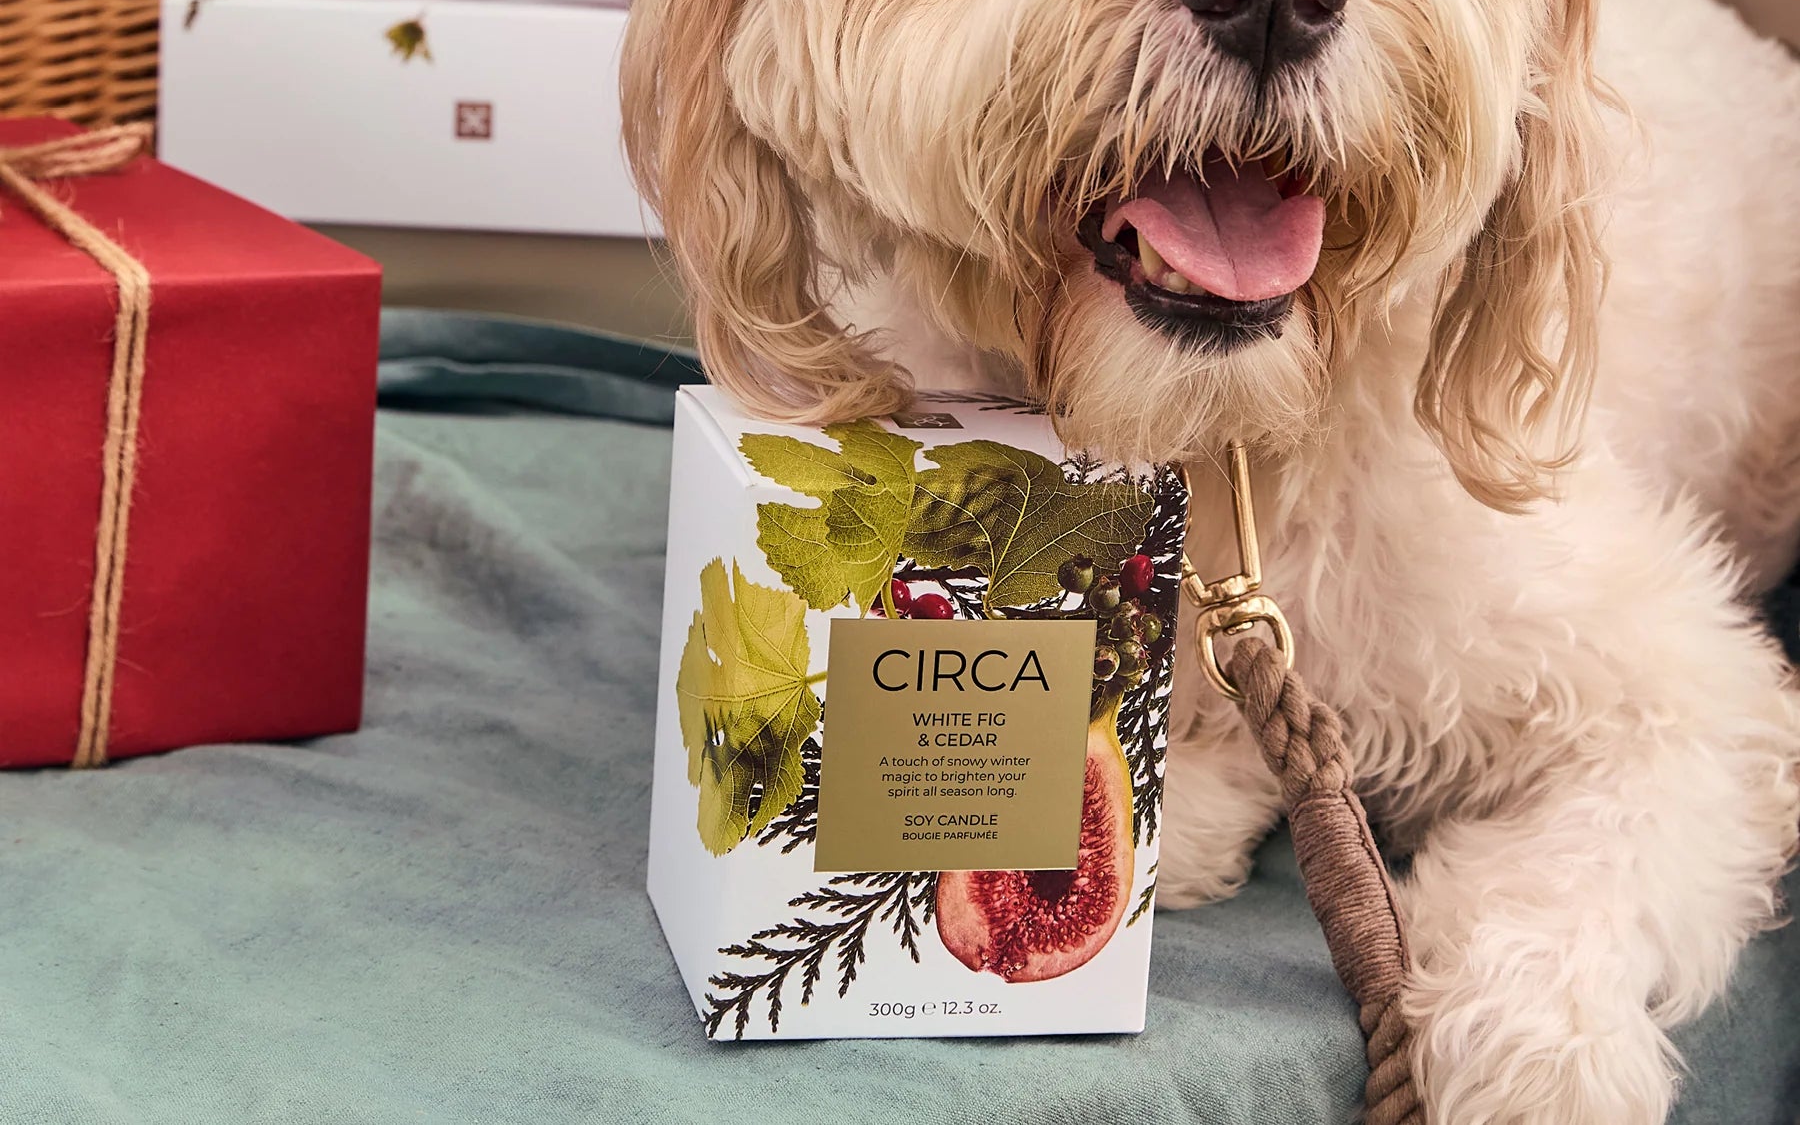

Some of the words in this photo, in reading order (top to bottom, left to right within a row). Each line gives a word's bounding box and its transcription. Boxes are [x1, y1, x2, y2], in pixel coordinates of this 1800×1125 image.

[872, 649, 1050, 692] CIRCA
[912, 712, 972, 726] WHITE
[977, 712, 1006, 726] FIG
[917, 733, 930, 747] &
[934, 733, 998, 747] CEDAR
[879, 756, 889, 767] A
[891, 756, 929, 767] touch
[932, 756, 945, 767] of
[947, 758, 988, 769] snowy
[990, 756, 1031, 767] winter
[881, 771, 923, 784] magic
[925, 772, 938, 782] to
[941, 771, 995, 784] brighten
[998, 772, 1027, 783] your
[888, 786, 919, 799] spirit
[922, 786, 937, 797] all
[940, 787, 983, 797] season
[987, 786, 1017, 799] long.
[904, 814, 934, 826] SOY
[937, 814, 998, 826] CANDLE
[902, 831, 941, 840] BOUGIE
[944, 829, 998, 840] PARFUMÉE
[869, 1002, 916, 1019] 300g
[942, 1001, 973, 1015] 12.3
[978, 1003, 1002, 1014] oz.
